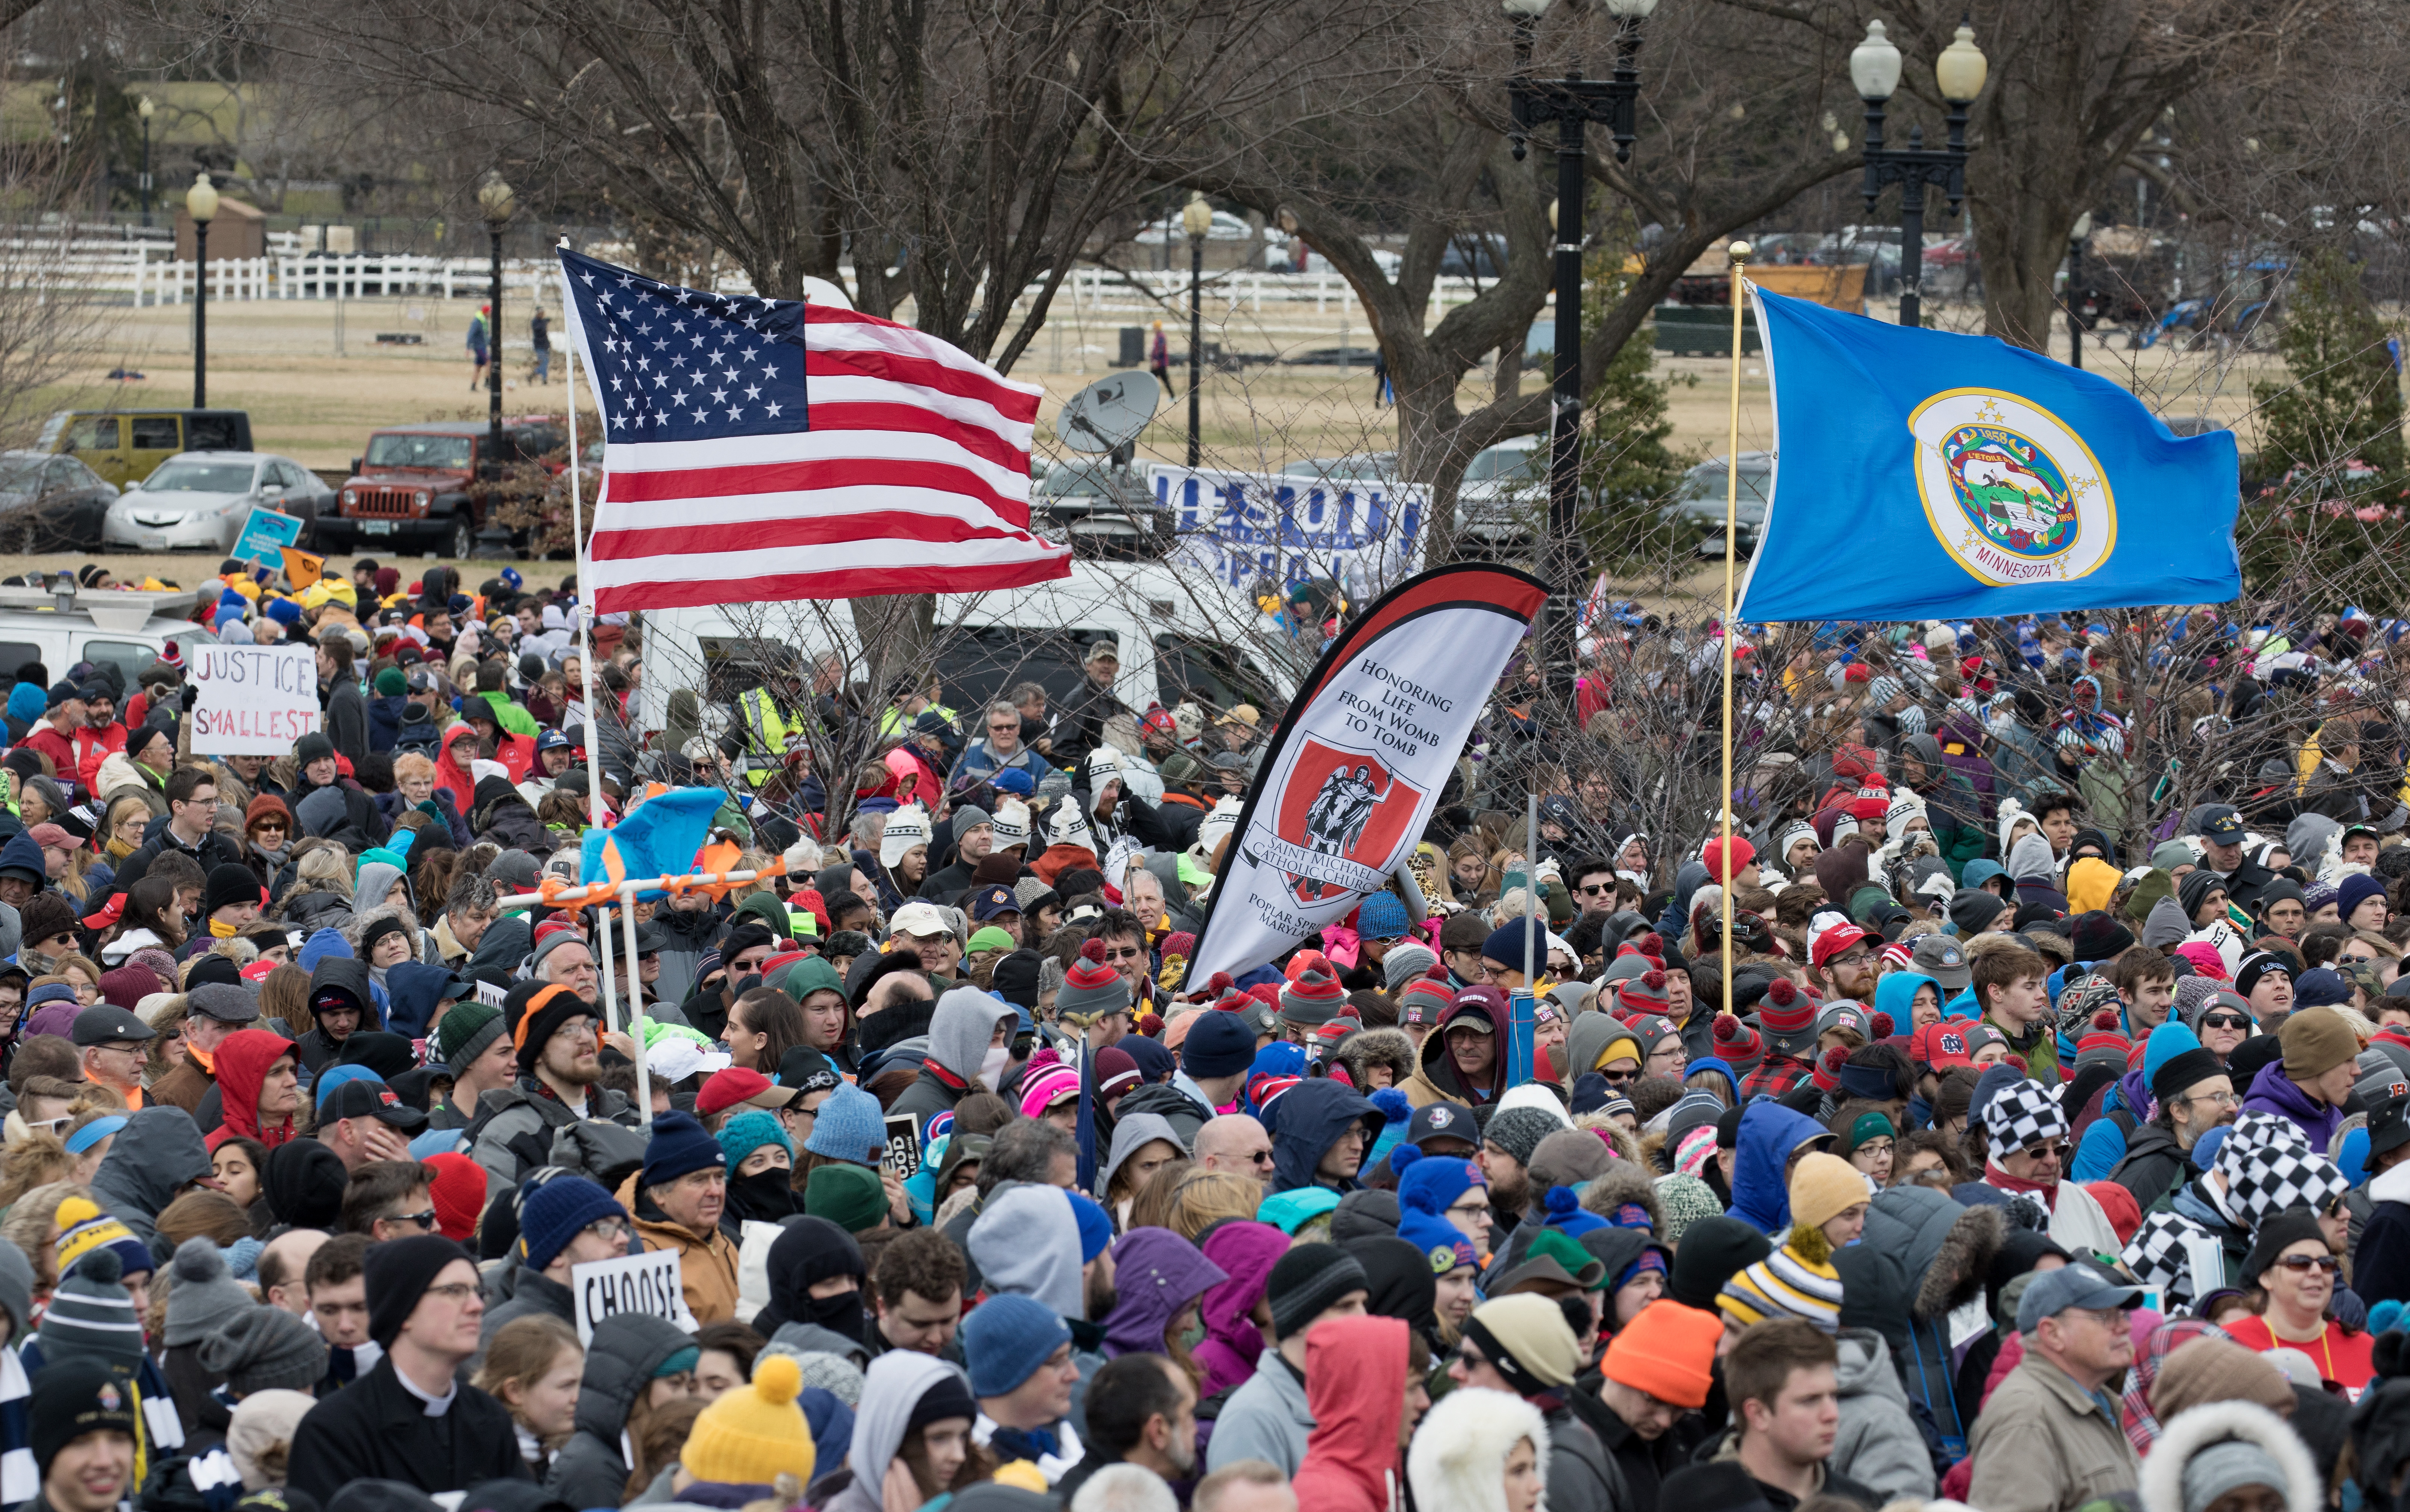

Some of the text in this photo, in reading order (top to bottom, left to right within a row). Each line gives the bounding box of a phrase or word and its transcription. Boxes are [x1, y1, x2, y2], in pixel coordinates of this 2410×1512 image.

[1979, 429, 2007, 444] 1858
[1968, 452, 2036, 477] L'ETOILE DU NORD
[2057, 513, 2074, 522] 1893
[1976, 547, 2051, 578] MINNESOTA
[197, 652, 311, 697] JUSTICE
[1359, 659, 1452, 712] HONORING
[1380, 689, 1416, 716] LIFE
[196, 709, 313, 740] SMALLEST
[1338, 690, 1439, 747] FROM WOMB
[1344, 712, 1417, 756] TO TOMB
[1253, 843, 1318, 878] CATHOLIC
[1268, 837, 1372, 881] SAINT MICHAEL
[1248, 893, 1320, 930] POPLAR SPRI
[1259, 912, 1310, 937] MARYLAN
[1539, 1011, 1554, 1021] LIFE
[2204, 999, 2219, 1010] LIFE
[1840, 1019, 1855, 1027] LIFE
[907, 1136, 917, 1175] LIFE.ORG
[586, 1265, 677, 1330] CHOOSE
